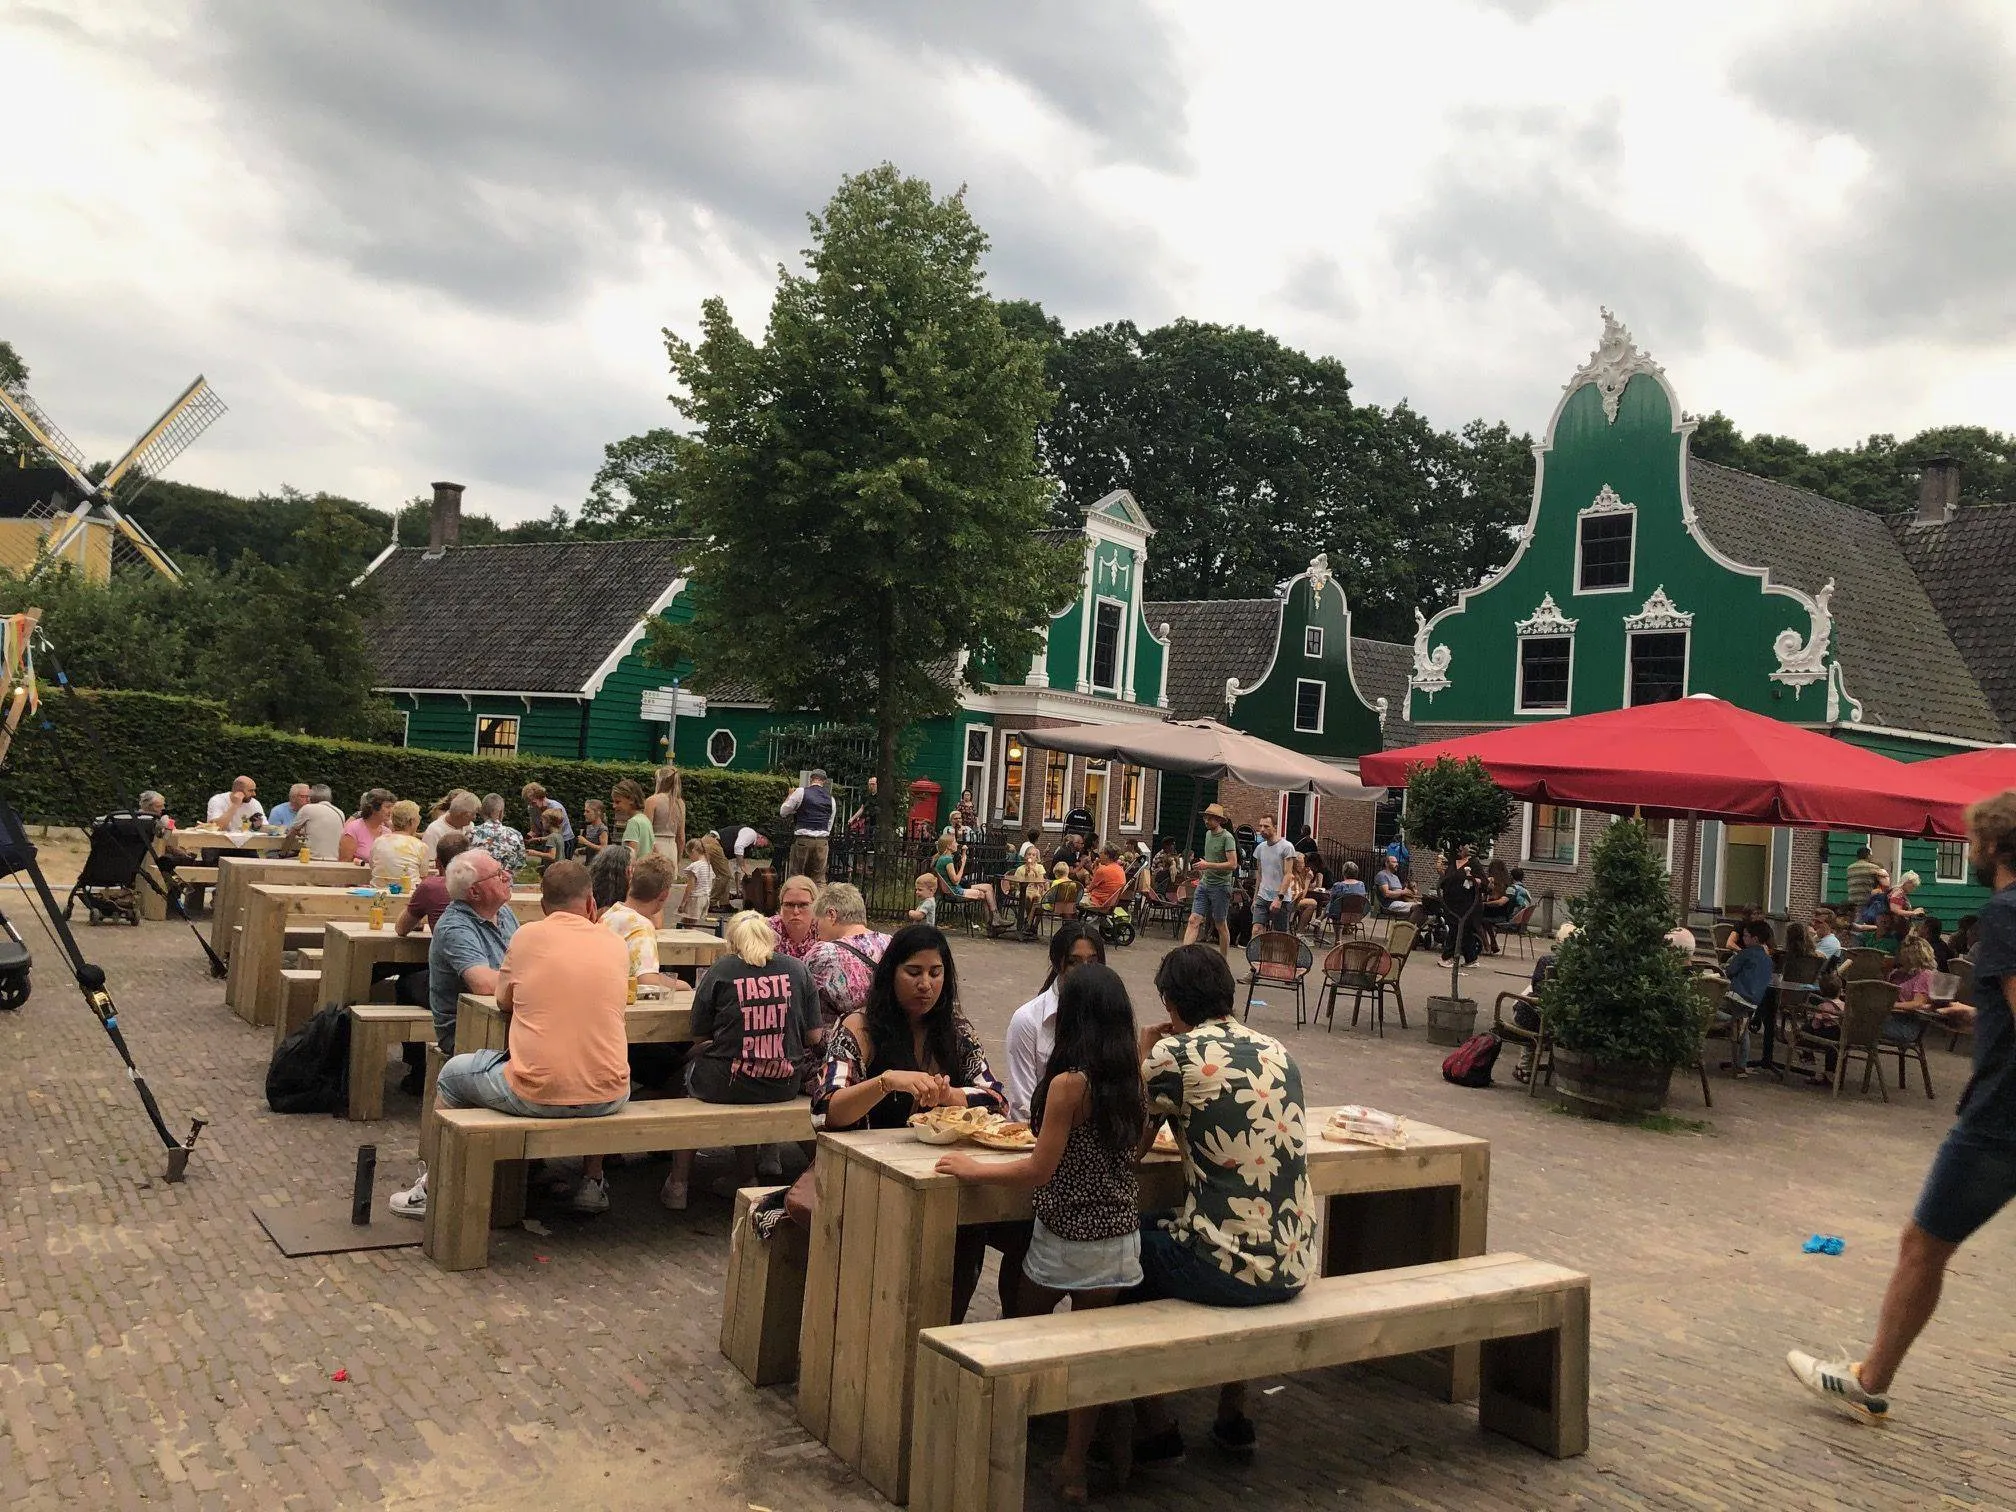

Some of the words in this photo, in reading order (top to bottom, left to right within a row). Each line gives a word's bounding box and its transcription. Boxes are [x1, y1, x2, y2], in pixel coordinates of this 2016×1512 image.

[733, 974, 792, 1003] TASTE
[741, 1003, 787, 1031] THAT
[742, 1033, 785, 1059] PINK
